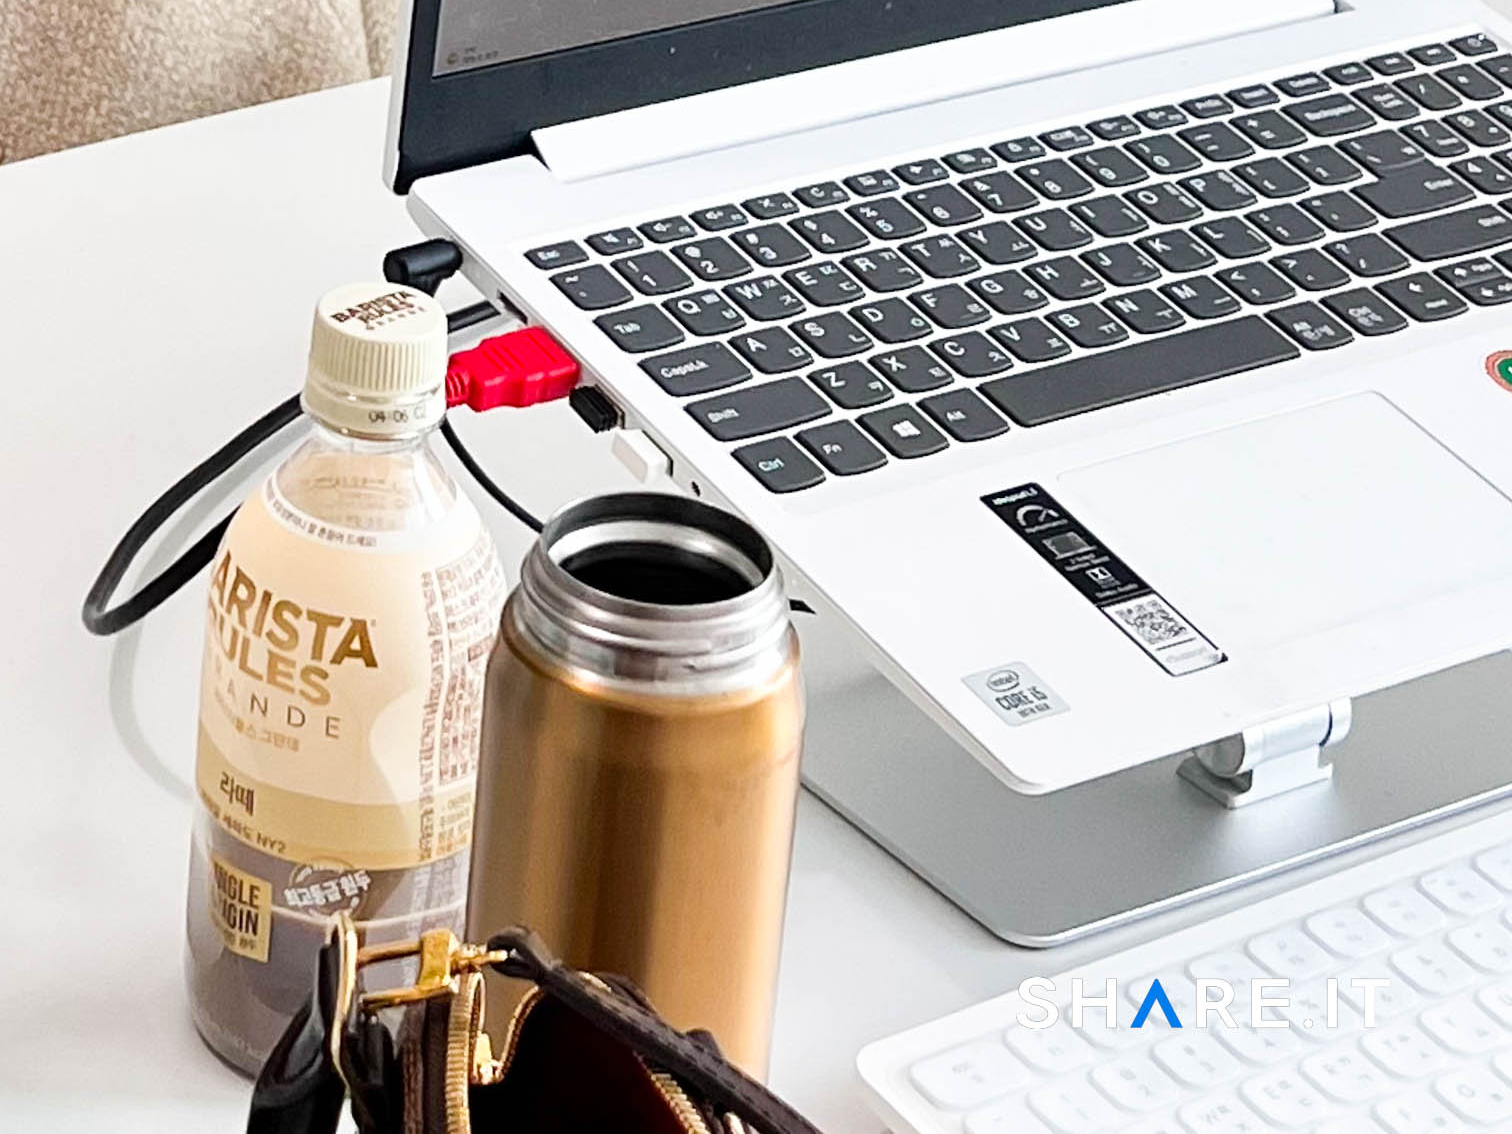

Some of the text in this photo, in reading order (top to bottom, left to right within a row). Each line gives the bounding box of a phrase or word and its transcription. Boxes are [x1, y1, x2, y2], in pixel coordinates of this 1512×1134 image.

[614, 323, 640, 333] Tab
[211, 549, 378, 669] ARISTA
[995, 690, 1030, 710] CORE
[219, 771, 255, 816] 라떼
